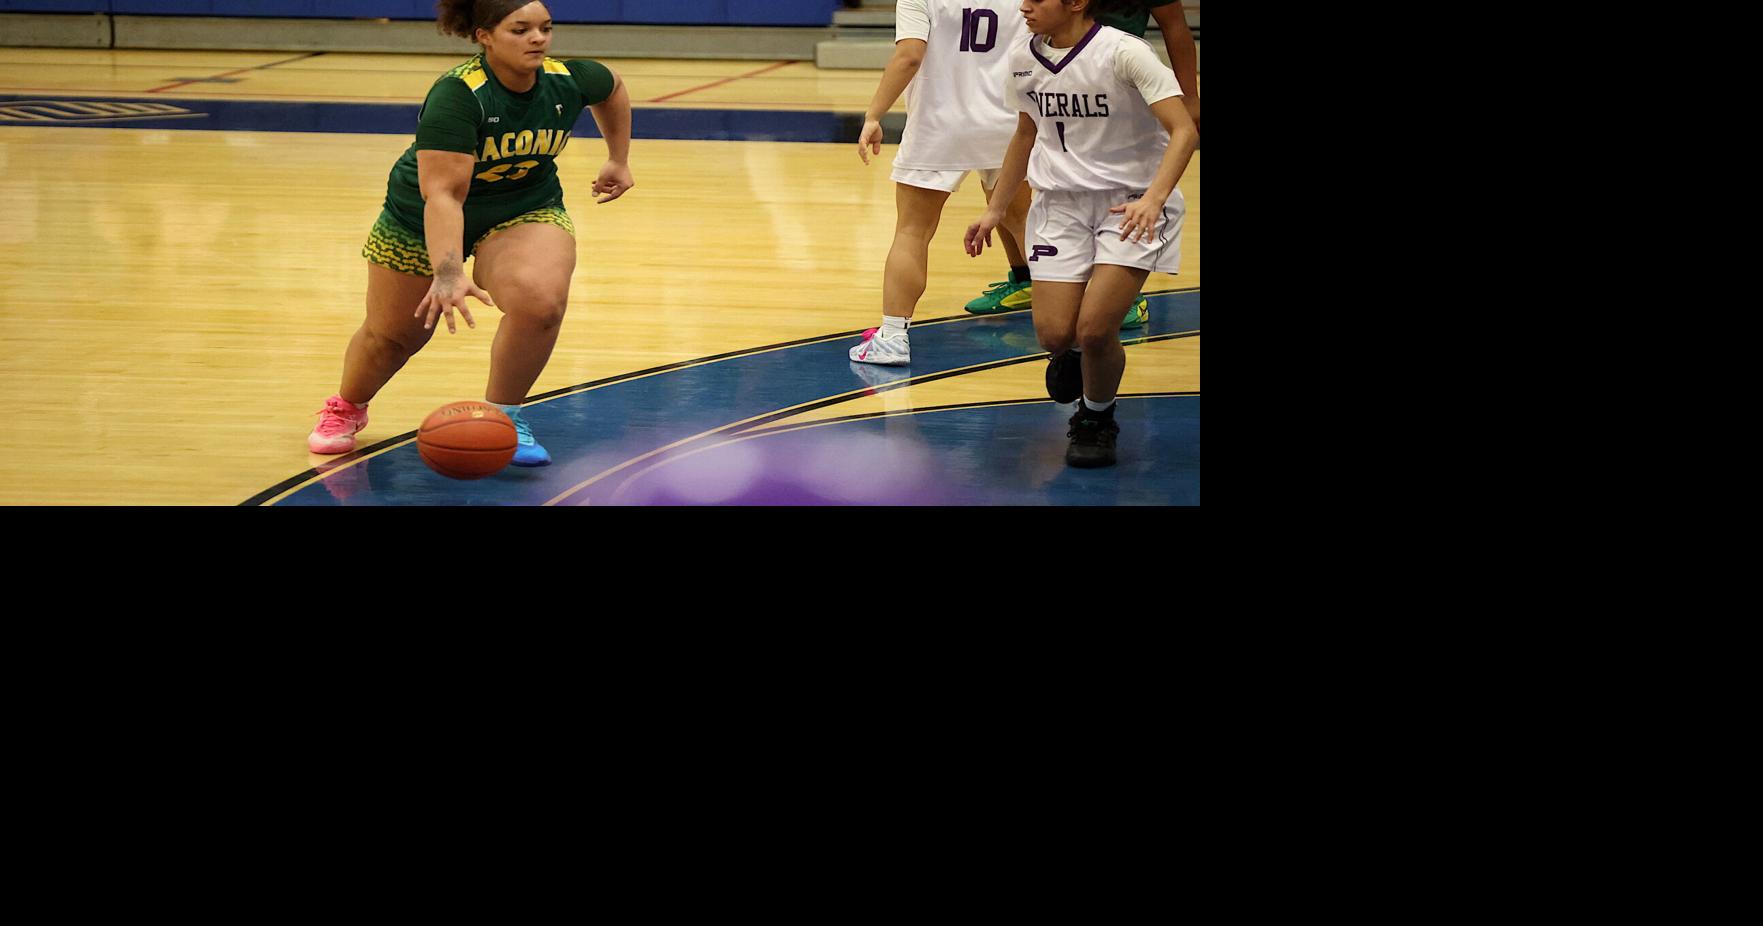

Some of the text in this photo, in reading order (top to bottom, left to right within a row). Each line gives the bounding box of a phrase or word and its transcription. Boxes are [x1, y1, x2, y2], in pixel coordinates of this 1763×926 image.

[959, 7, 998, 53] 10
[473, 128, 571, 162] ACONI
[1055, 121, 1068, 152] 1
[1028, 244, 1059, 262] P
